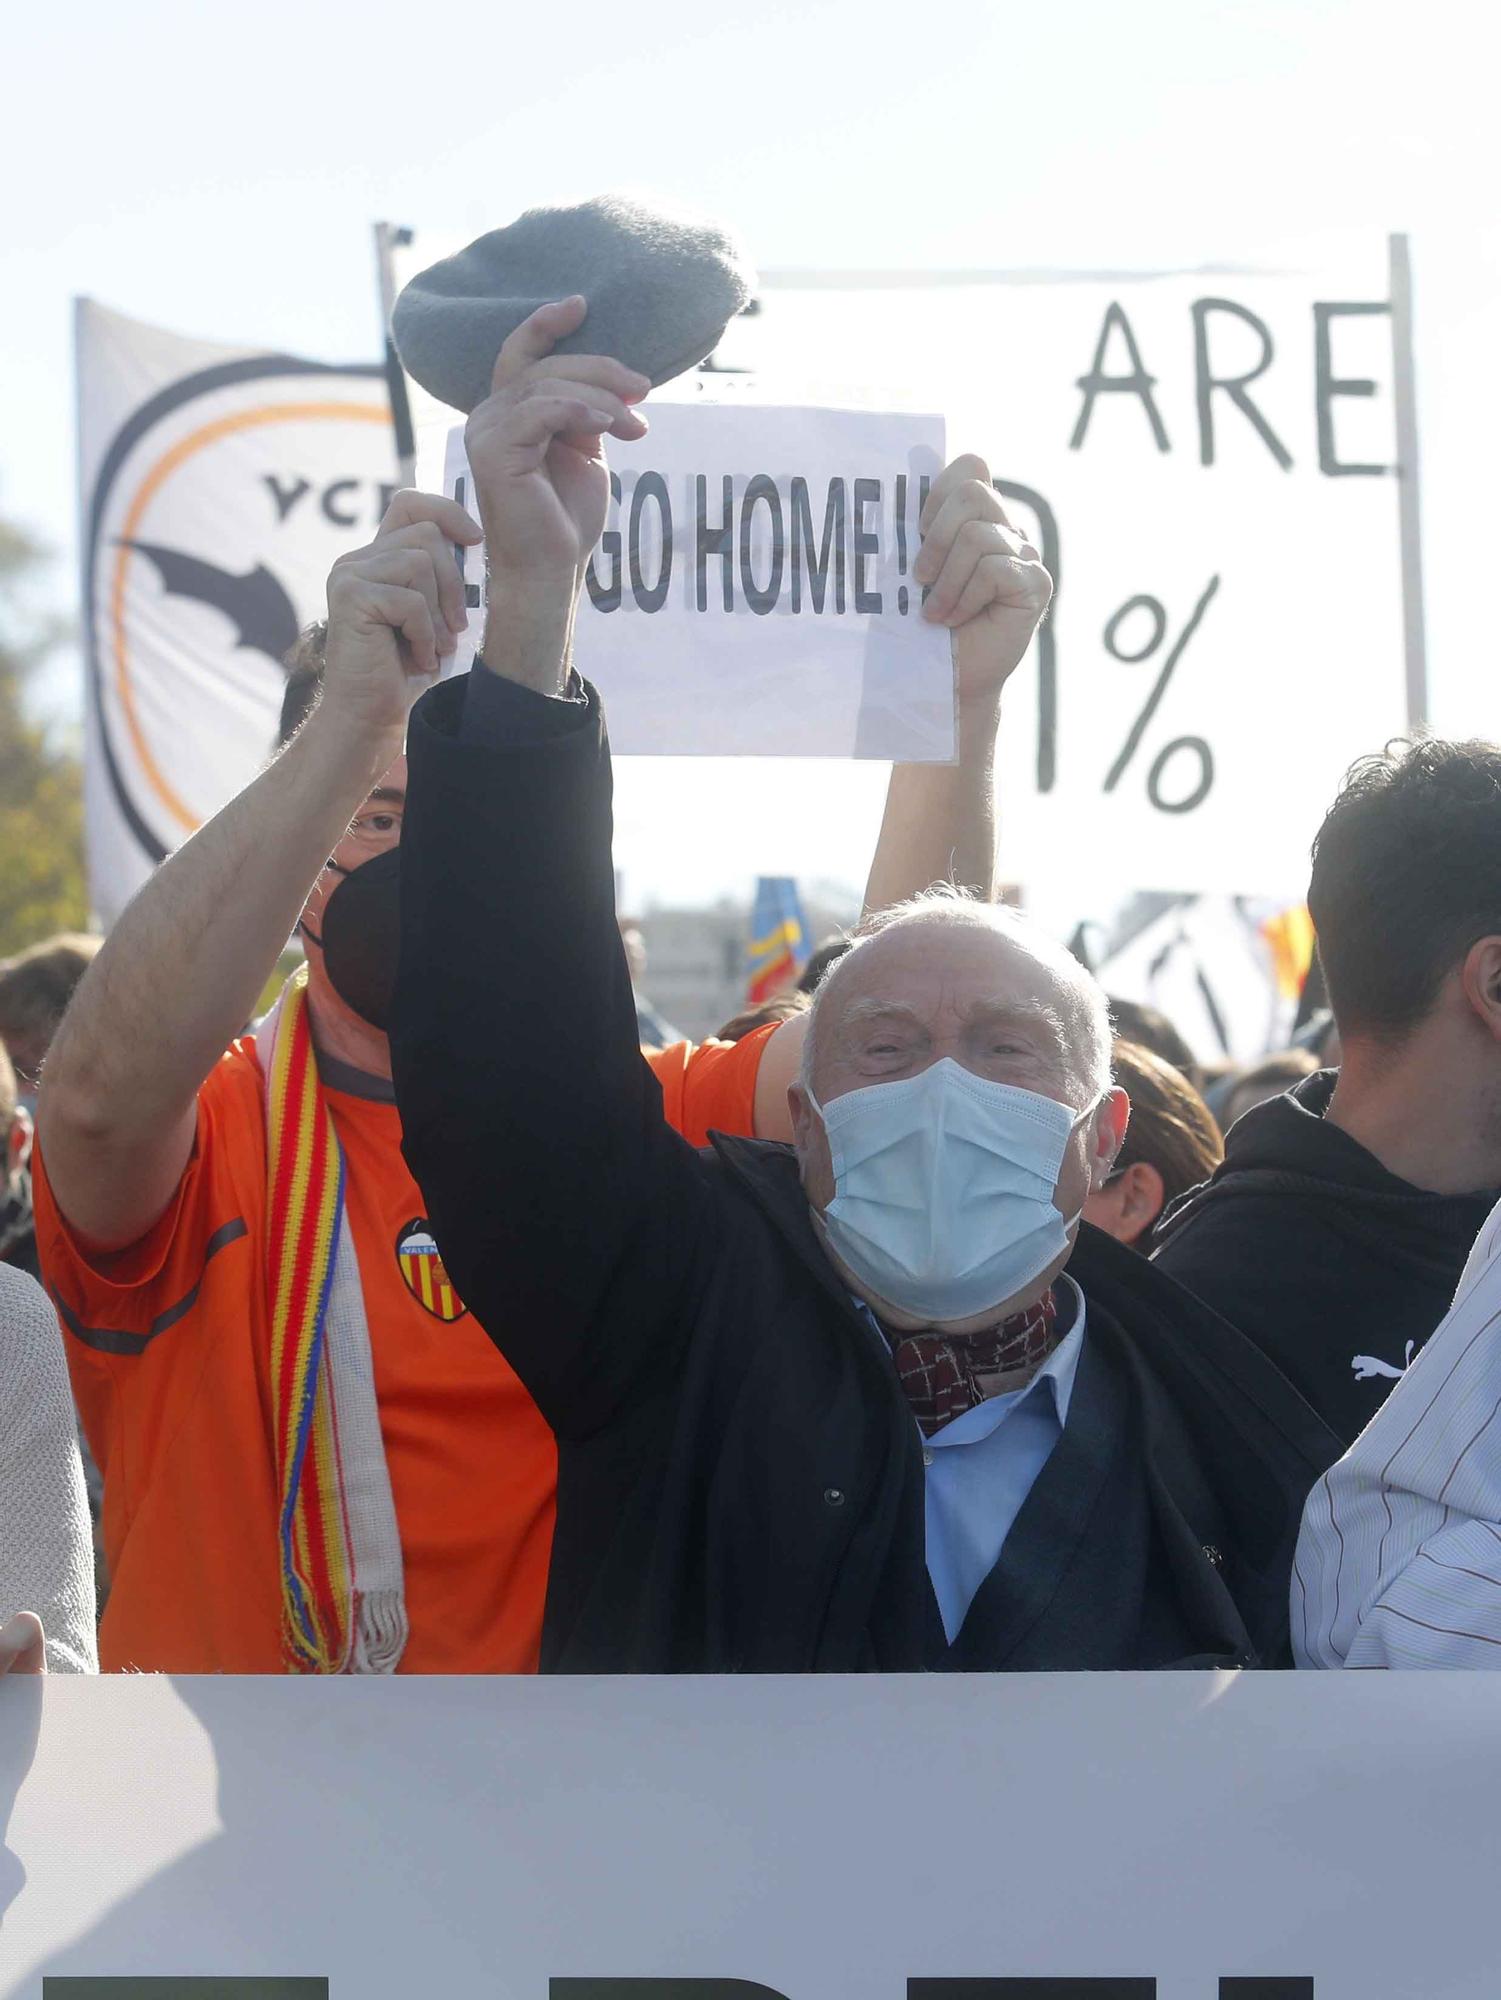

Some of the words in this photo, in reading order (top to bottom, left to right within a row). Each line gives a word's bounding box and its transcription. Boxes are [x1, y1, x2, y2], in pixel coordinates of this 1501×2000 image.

[1069, 297, 1396, 477] ARE
[585, 470, 673, 614] GO
[403, 1246, 438, 1255] VALEN
